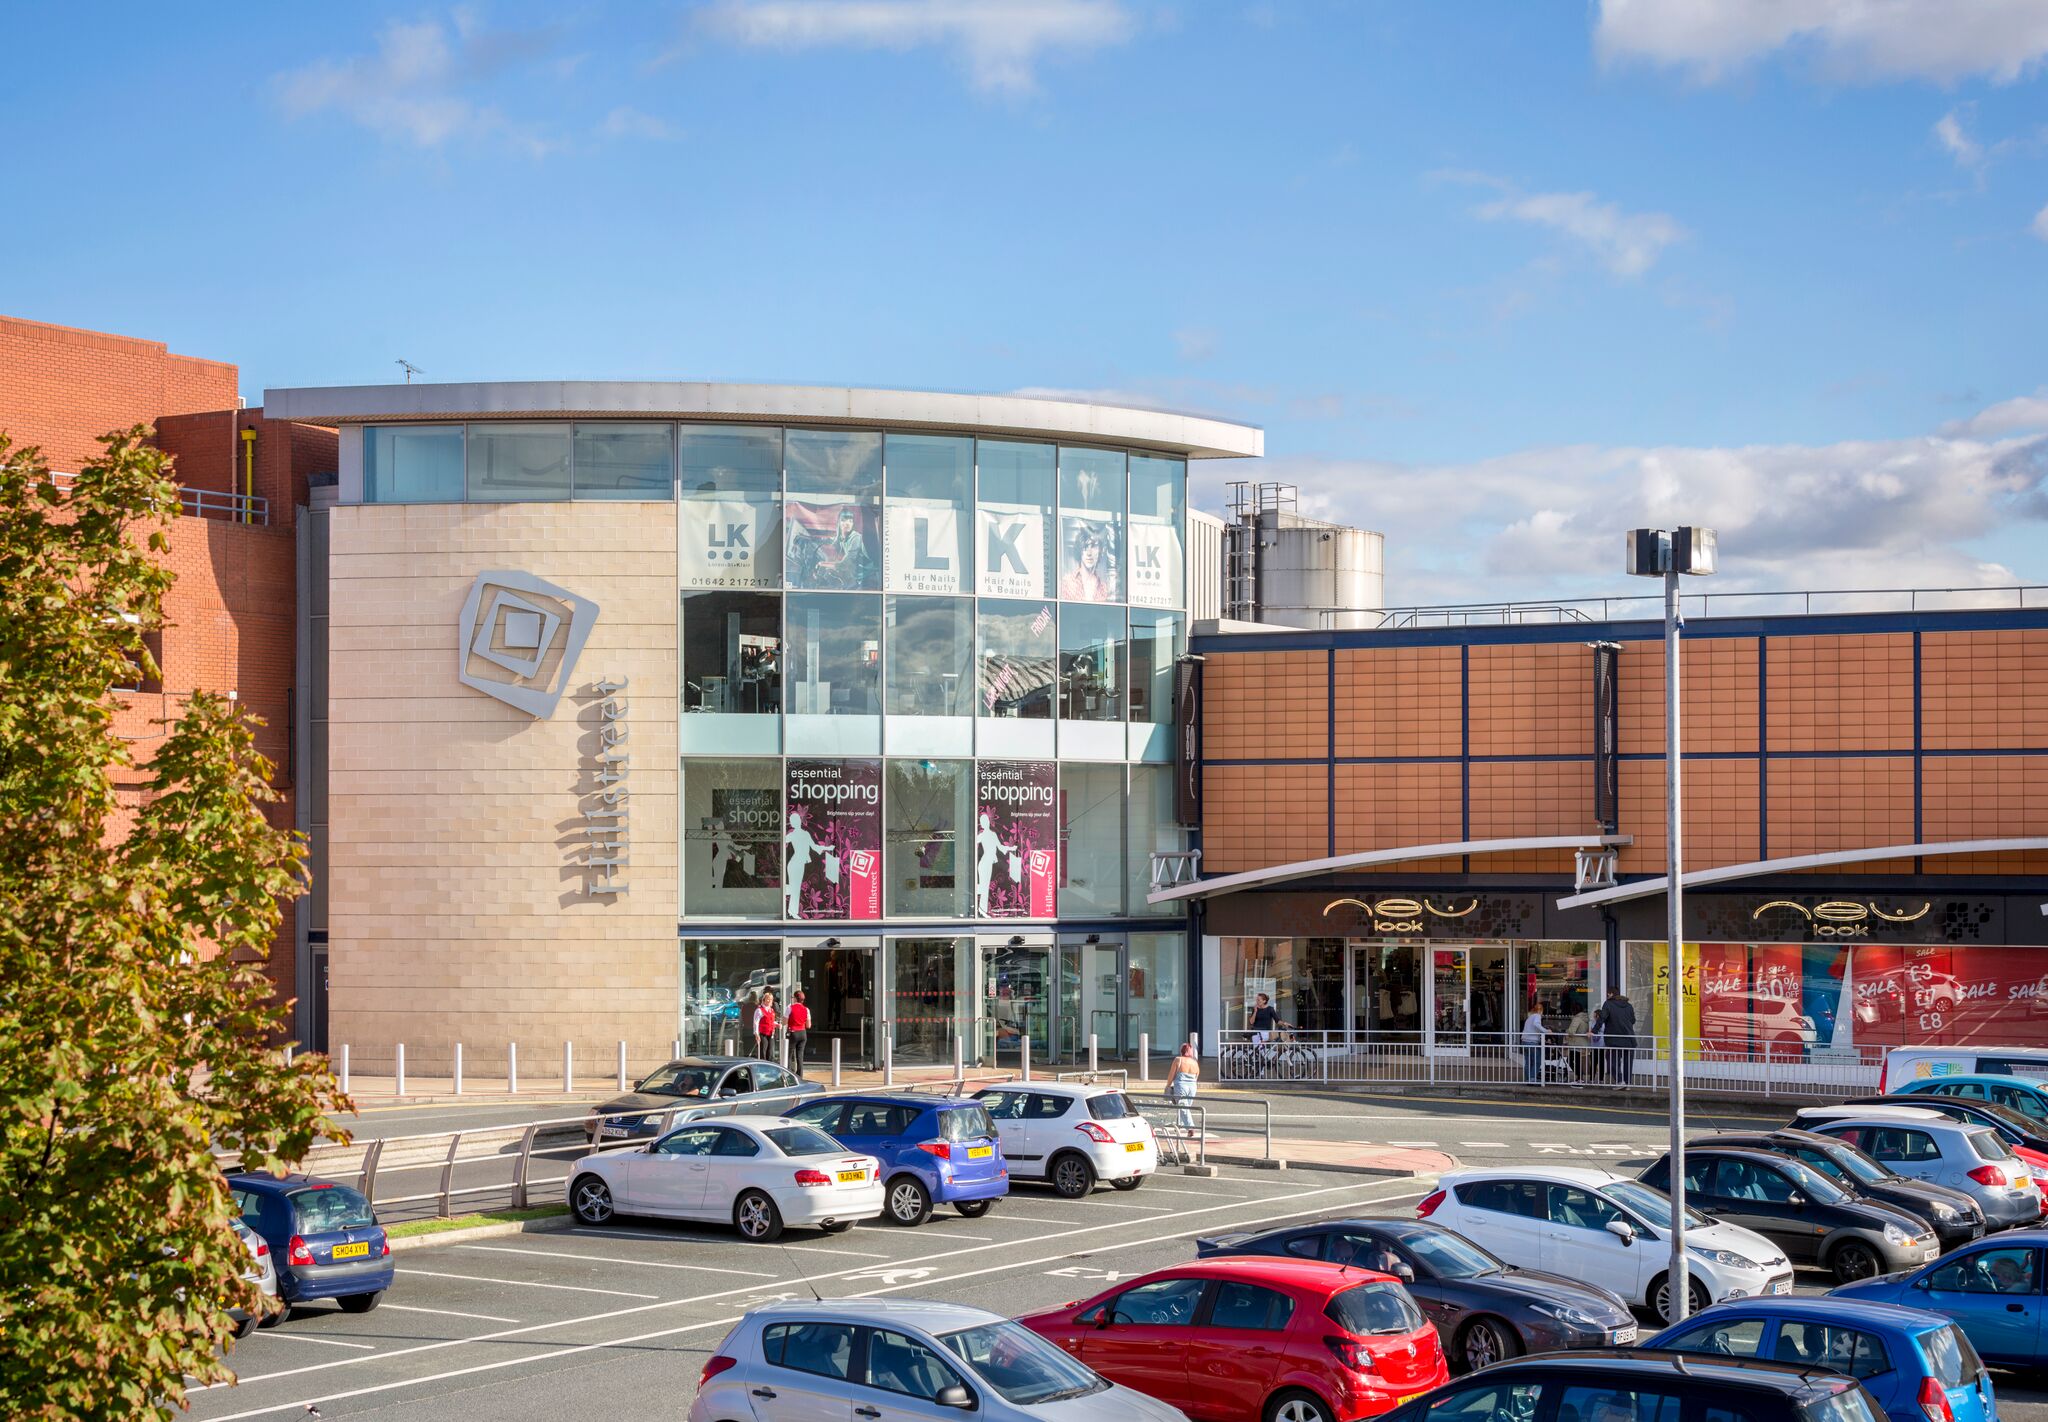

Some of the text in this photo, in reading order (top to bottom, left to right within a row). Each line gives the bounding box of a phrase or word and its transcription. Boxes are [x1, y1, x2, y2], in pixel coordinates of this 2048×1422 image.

[708, 524, 750, 547] LK
[914, 517, 950, 570] L
[987, 521, 1029, 574] K
[1135, 545, 1161, 568] LK
[691, 578, 769, 586] 01642 217217
[906, 582, 953, 592] & Beauty
[930, 574, 956, 583] Nails
[984, 576, 1031, 587] Hair Nails
[987, 585, 1029, 596] & Beauty
[1030, 605, 1053, 638] FRIDAY
[791, 767, 842, 778] essential
[981, 769, 1024, 780] essential
[584, 675, 630, 897] Hillstreet
[790, 779, 879, 805] shopping
[980, 780, 1053, 806] shopping
[729, 796, 773, 806] essential
[729, 805, 780, 828] shopp
[868, 871, 878, 914] Hillstreet
[1045, 871, 1053, 912] Hillstreet
[1374, 919, 1424, 932] look
[1813, 923, 1868, 937] look
[1916, 948, 1936, 957] SALE
[1657, 965, 1697, 978] SE
[1909, 963, 1933, 982] £3
[1657, 984, 1697, 996] FIAL
[1704, 977, 1742, 995] SALE
[1756, 976, 1800, 1001] 50%
[1857, 979, 1896, 998] SALE
[1958, 982, 1998, 999] SALE
[2007, 983, 2048, 999] SALE
[1785, 991, 1799, 999] OFF
[1920, 1012, 1942, 1031] £8
